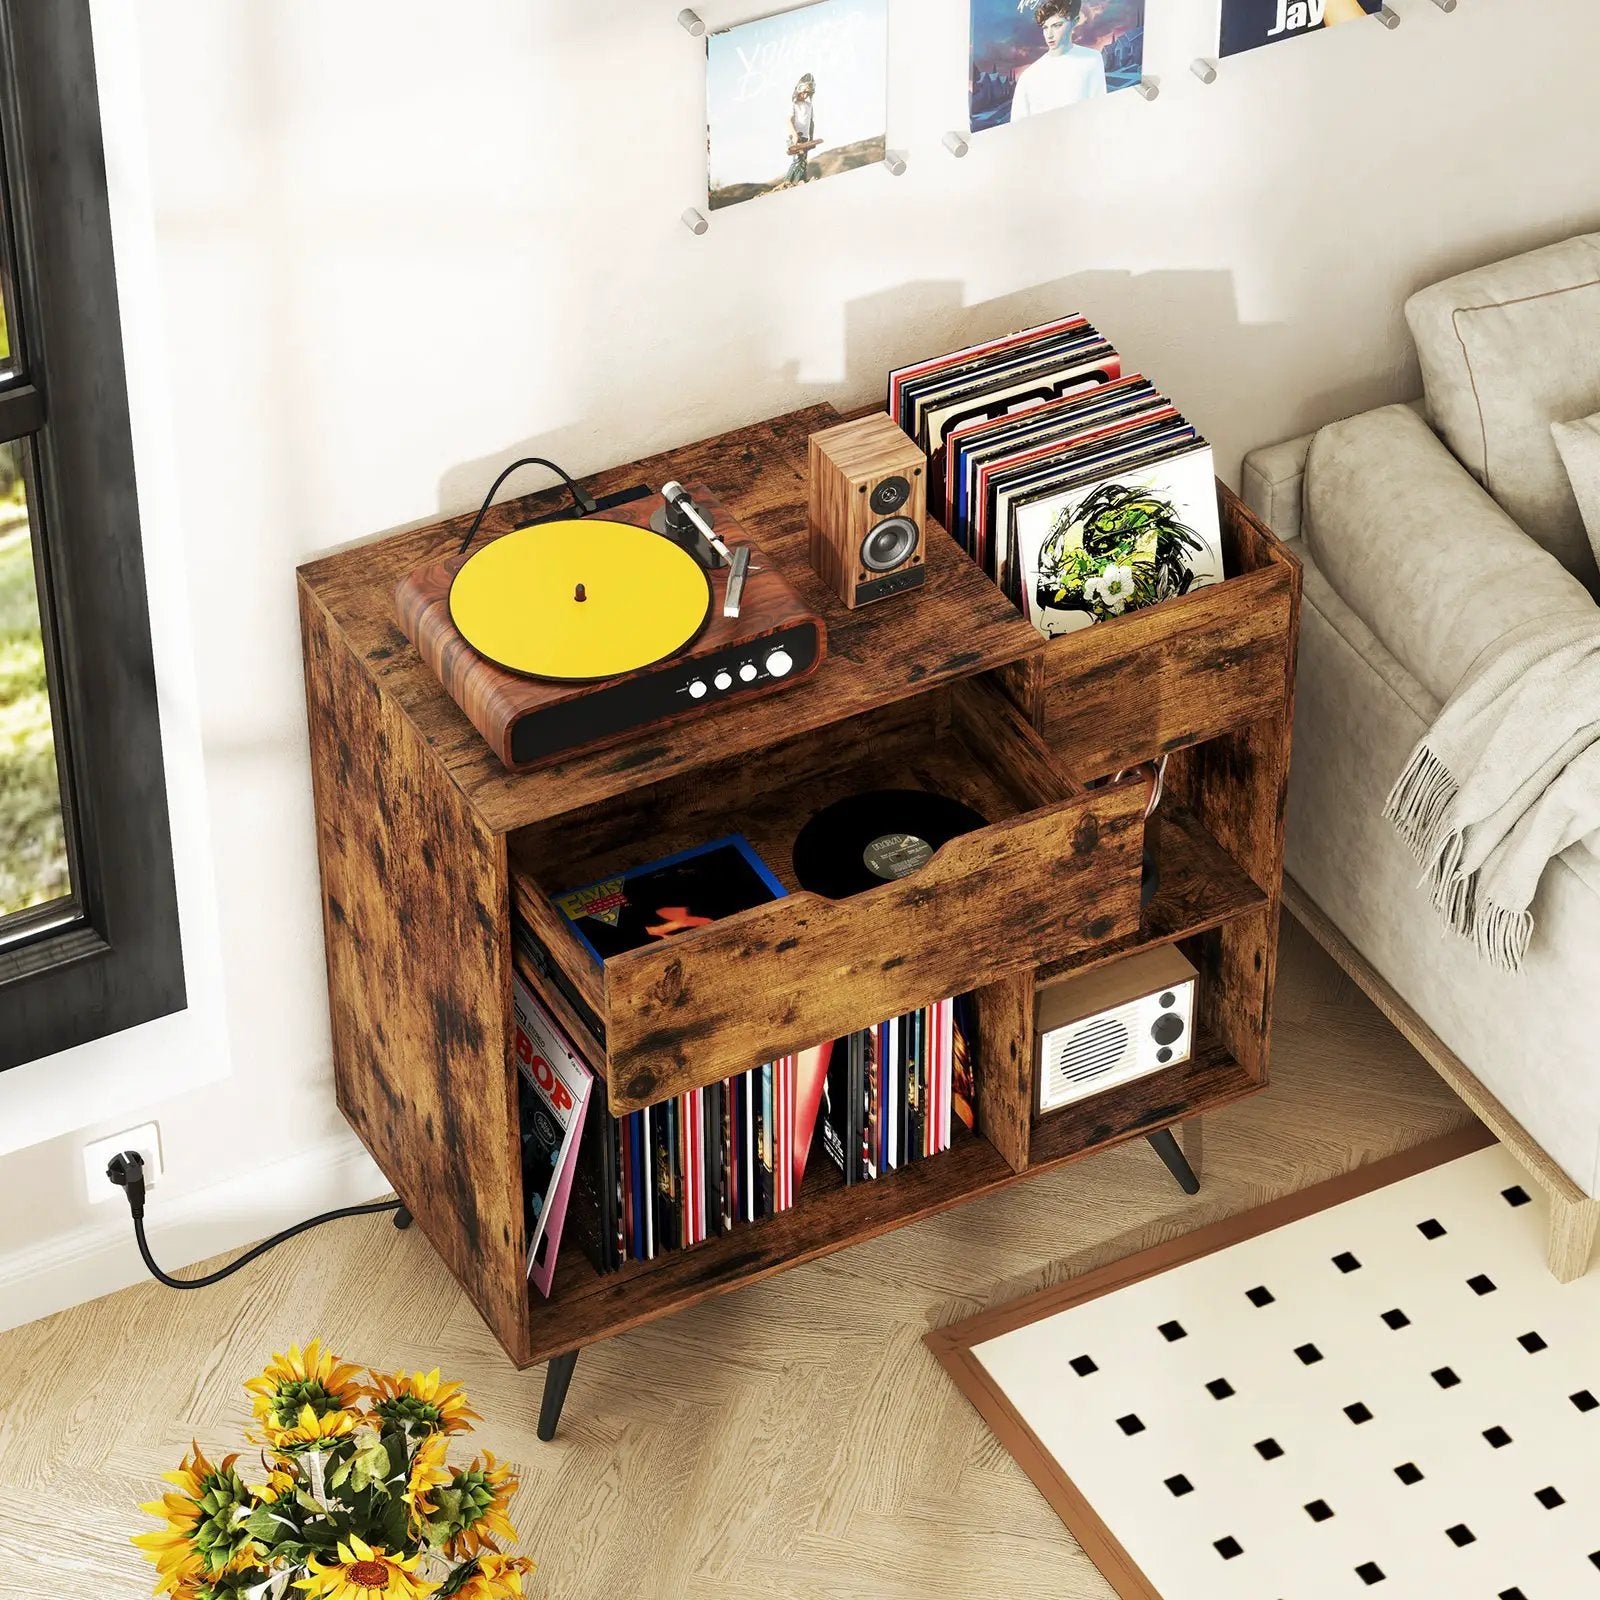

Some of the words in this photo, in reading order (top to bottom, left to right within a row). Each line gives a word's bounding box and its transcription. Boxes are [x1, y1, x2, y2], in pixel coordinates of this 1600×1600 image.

[1267, 0, 1326, 36] Jay
[560, 879, 622, 920] ELVIS
[516, 1024, 573, 1111] BOP
